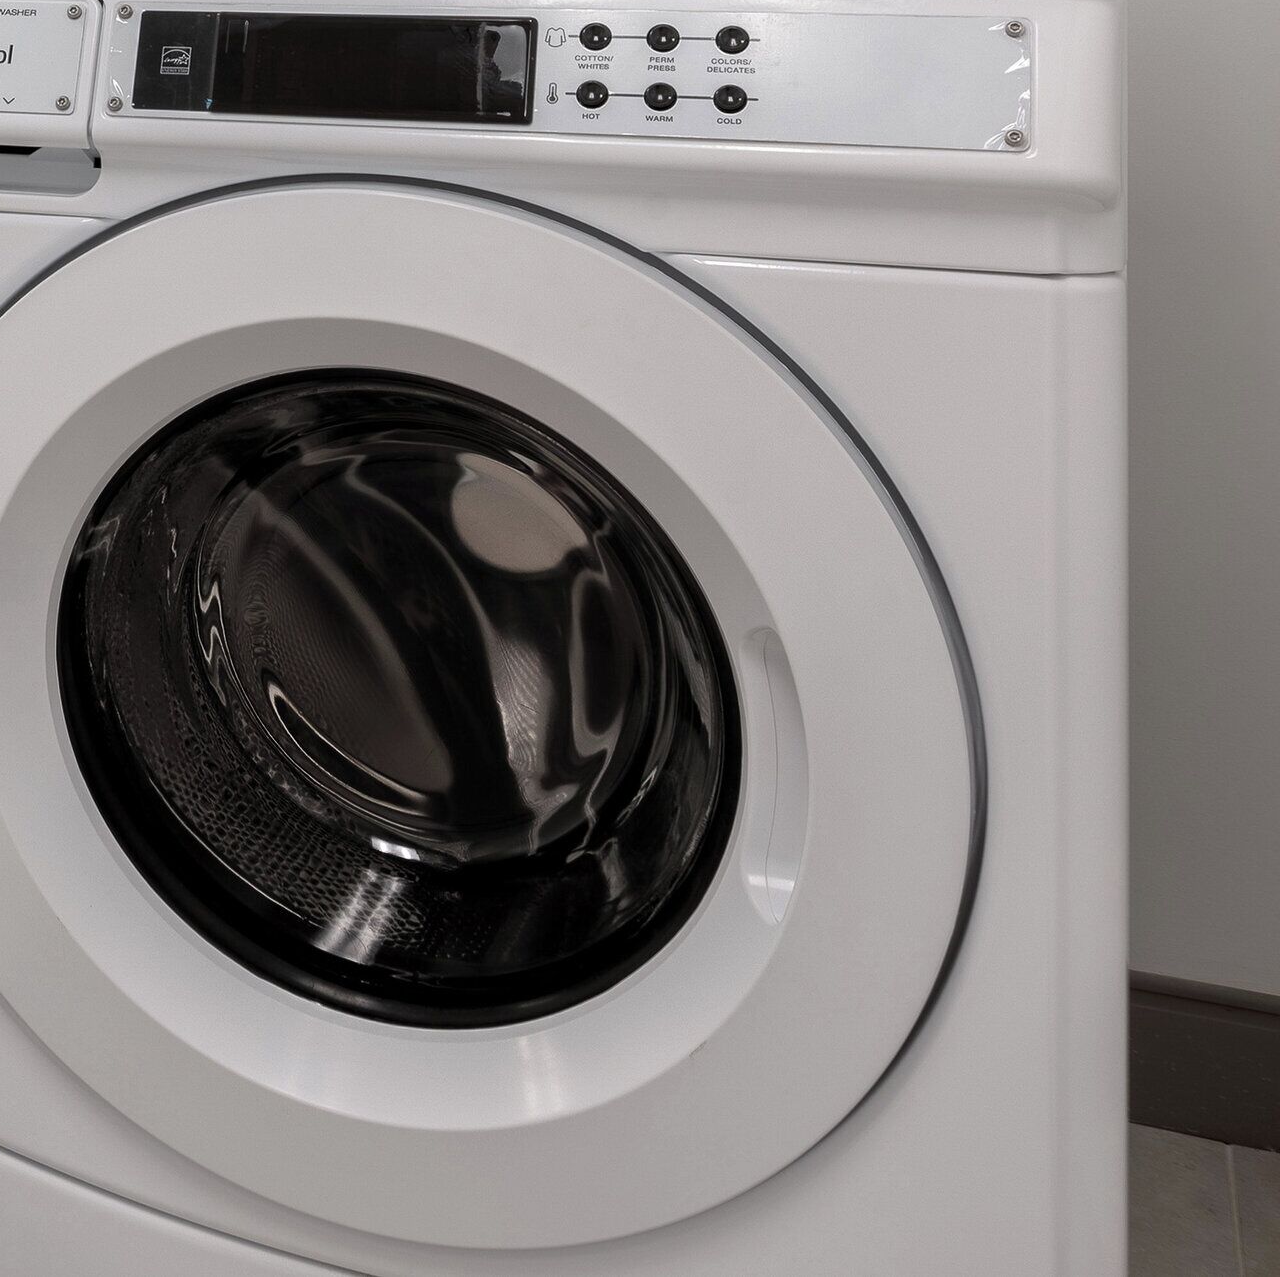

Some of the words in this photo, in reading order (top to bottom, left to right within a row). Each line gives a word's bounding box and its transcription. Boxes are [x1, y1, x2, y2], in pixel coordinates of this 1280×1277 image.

[574, 54, 614, 62] COTTON/
[647, 64, 676, 72] PRESS
[706, 66, 756, 74] DELICATES
[645, 115, 674, 123] WARM
[716, 117, 743, 125] COLD
